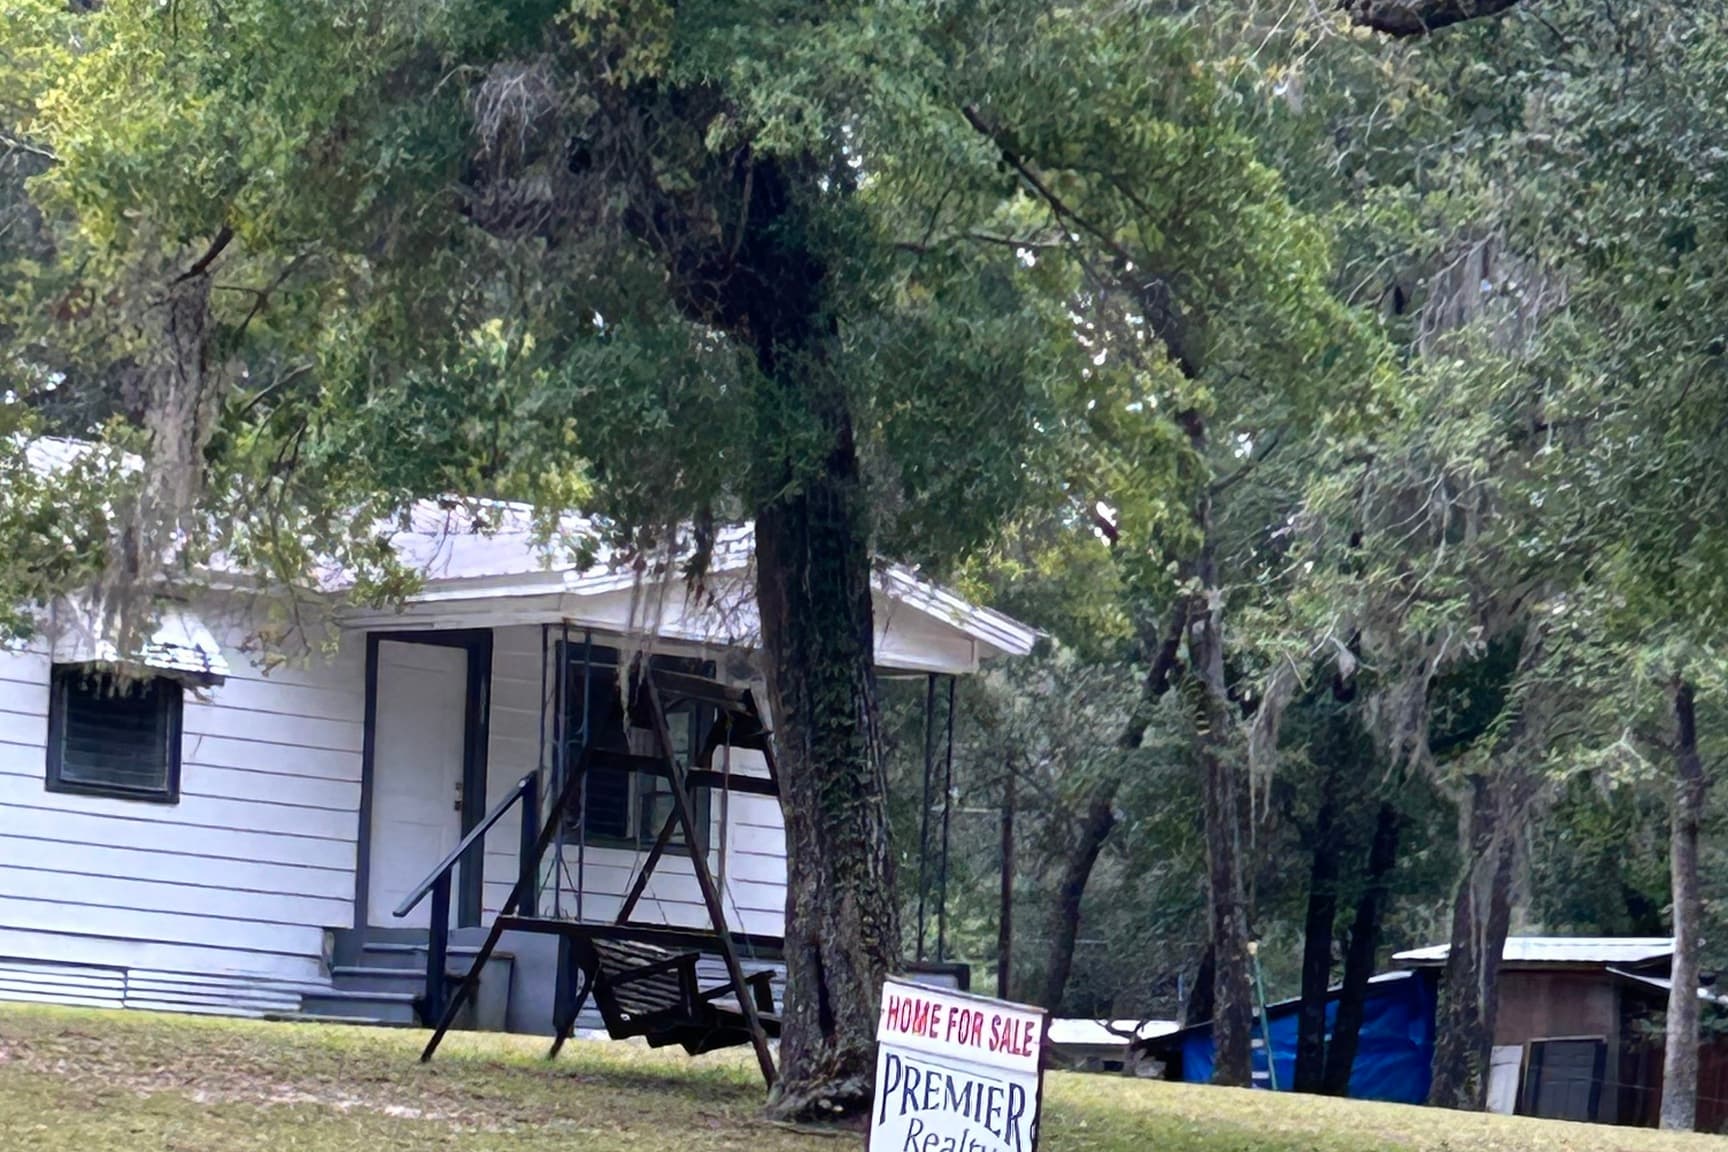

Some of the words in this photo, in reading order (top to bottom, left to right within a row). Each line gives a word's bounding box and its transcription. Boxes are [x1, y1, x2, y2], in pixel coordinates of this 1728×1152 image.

[887, 995, 943, 1038] HOME
[945, 1007, 984, 1048] FOR
[989, 1014, 1035, 1057] SALE
